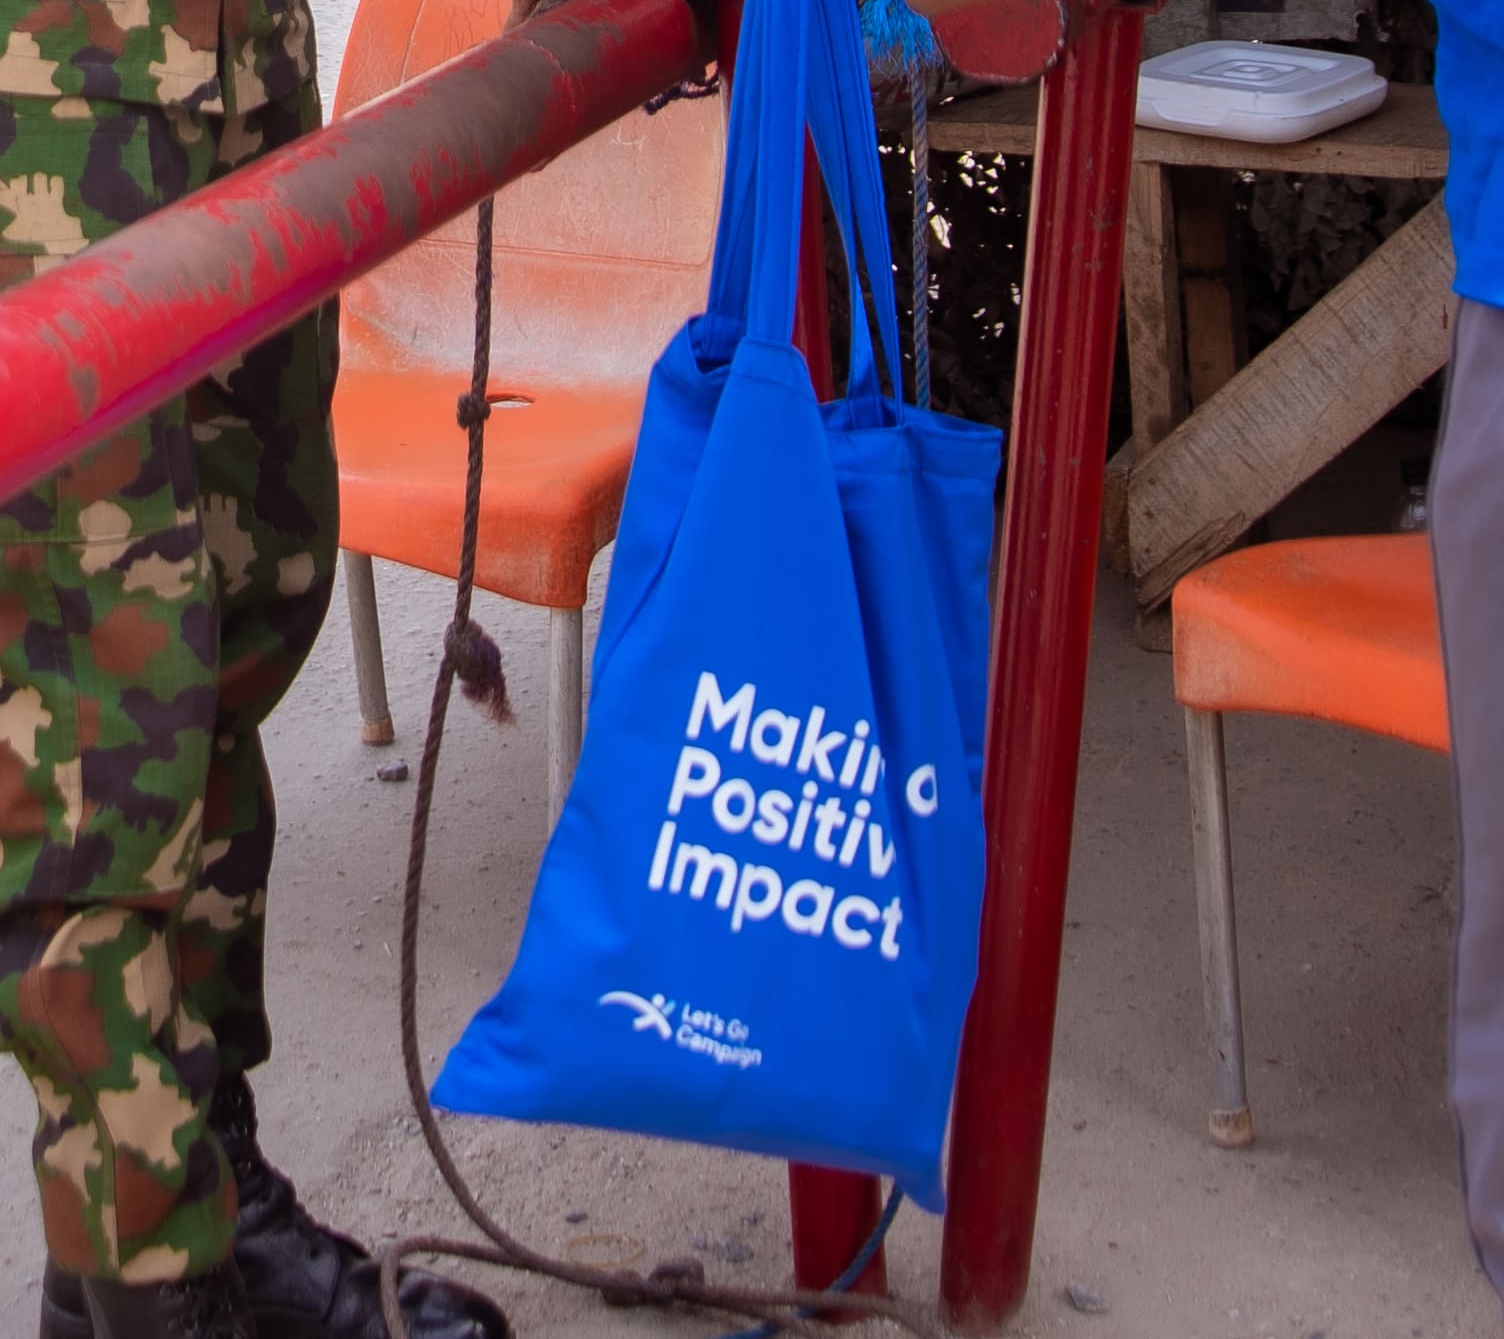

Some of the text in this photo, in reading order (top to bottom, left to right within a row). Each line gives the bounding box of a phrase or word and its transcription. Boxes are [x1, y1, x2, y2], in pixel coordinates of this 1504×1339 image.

[666, 746, 897, 880] Positiv
[647, 821, 903, 959] Impact
[676, 1023, 762, 1071] Campaign
